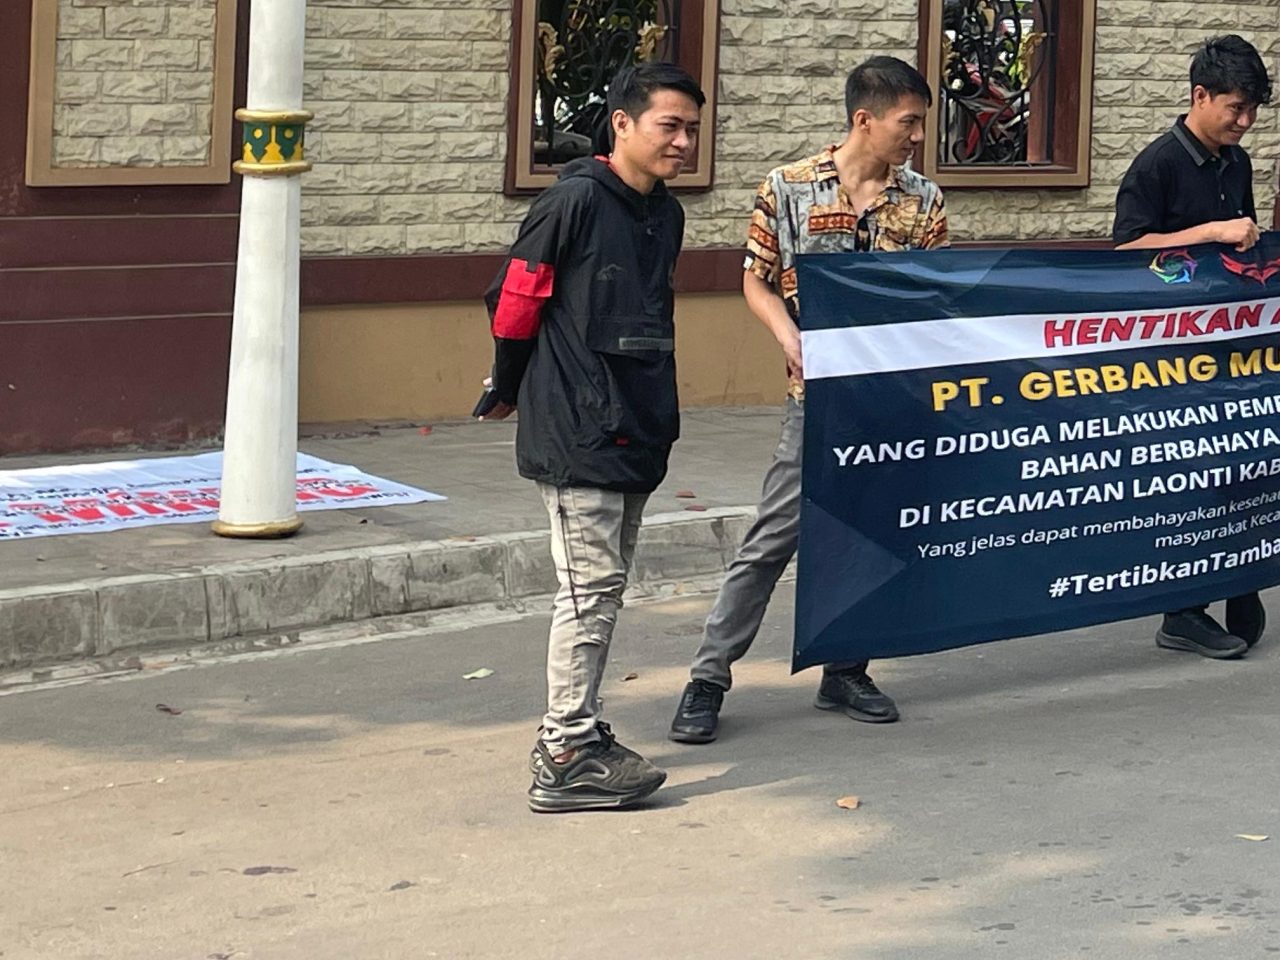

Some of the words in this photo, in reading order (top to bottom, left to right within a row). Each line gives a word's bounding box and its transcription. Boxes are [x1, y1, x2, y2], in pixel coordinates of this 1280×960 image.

[1043, 303, 1266, 348] HENTIKAN
[931, 377, 1004, 412] PT.
[1019, 354, 1218, 401] GERBANG
[832, 439, 926, 467] YANG
[935, 424, 1051, 457] DIDUGA
[1059, 404, 1219, 442] MELAKUKAN
[1020, 448, 1122, 481] BAHAN
[1130, 427, 1280, 466] BERBAHAYA
[899, 505, 931, 529] DI
[940, 480, 1124, 523] KECAMATAN
[1132, 465, 1232, 499] LAONTI
[917, 540, 967, 559] Yang
[968, 532, 1016, 556] jelas
[1020, 524, 1079, 545] dapat
[1083, 504, 1227, 537] membahayakan
[1154, 518, 1248, 548] masyarakat
